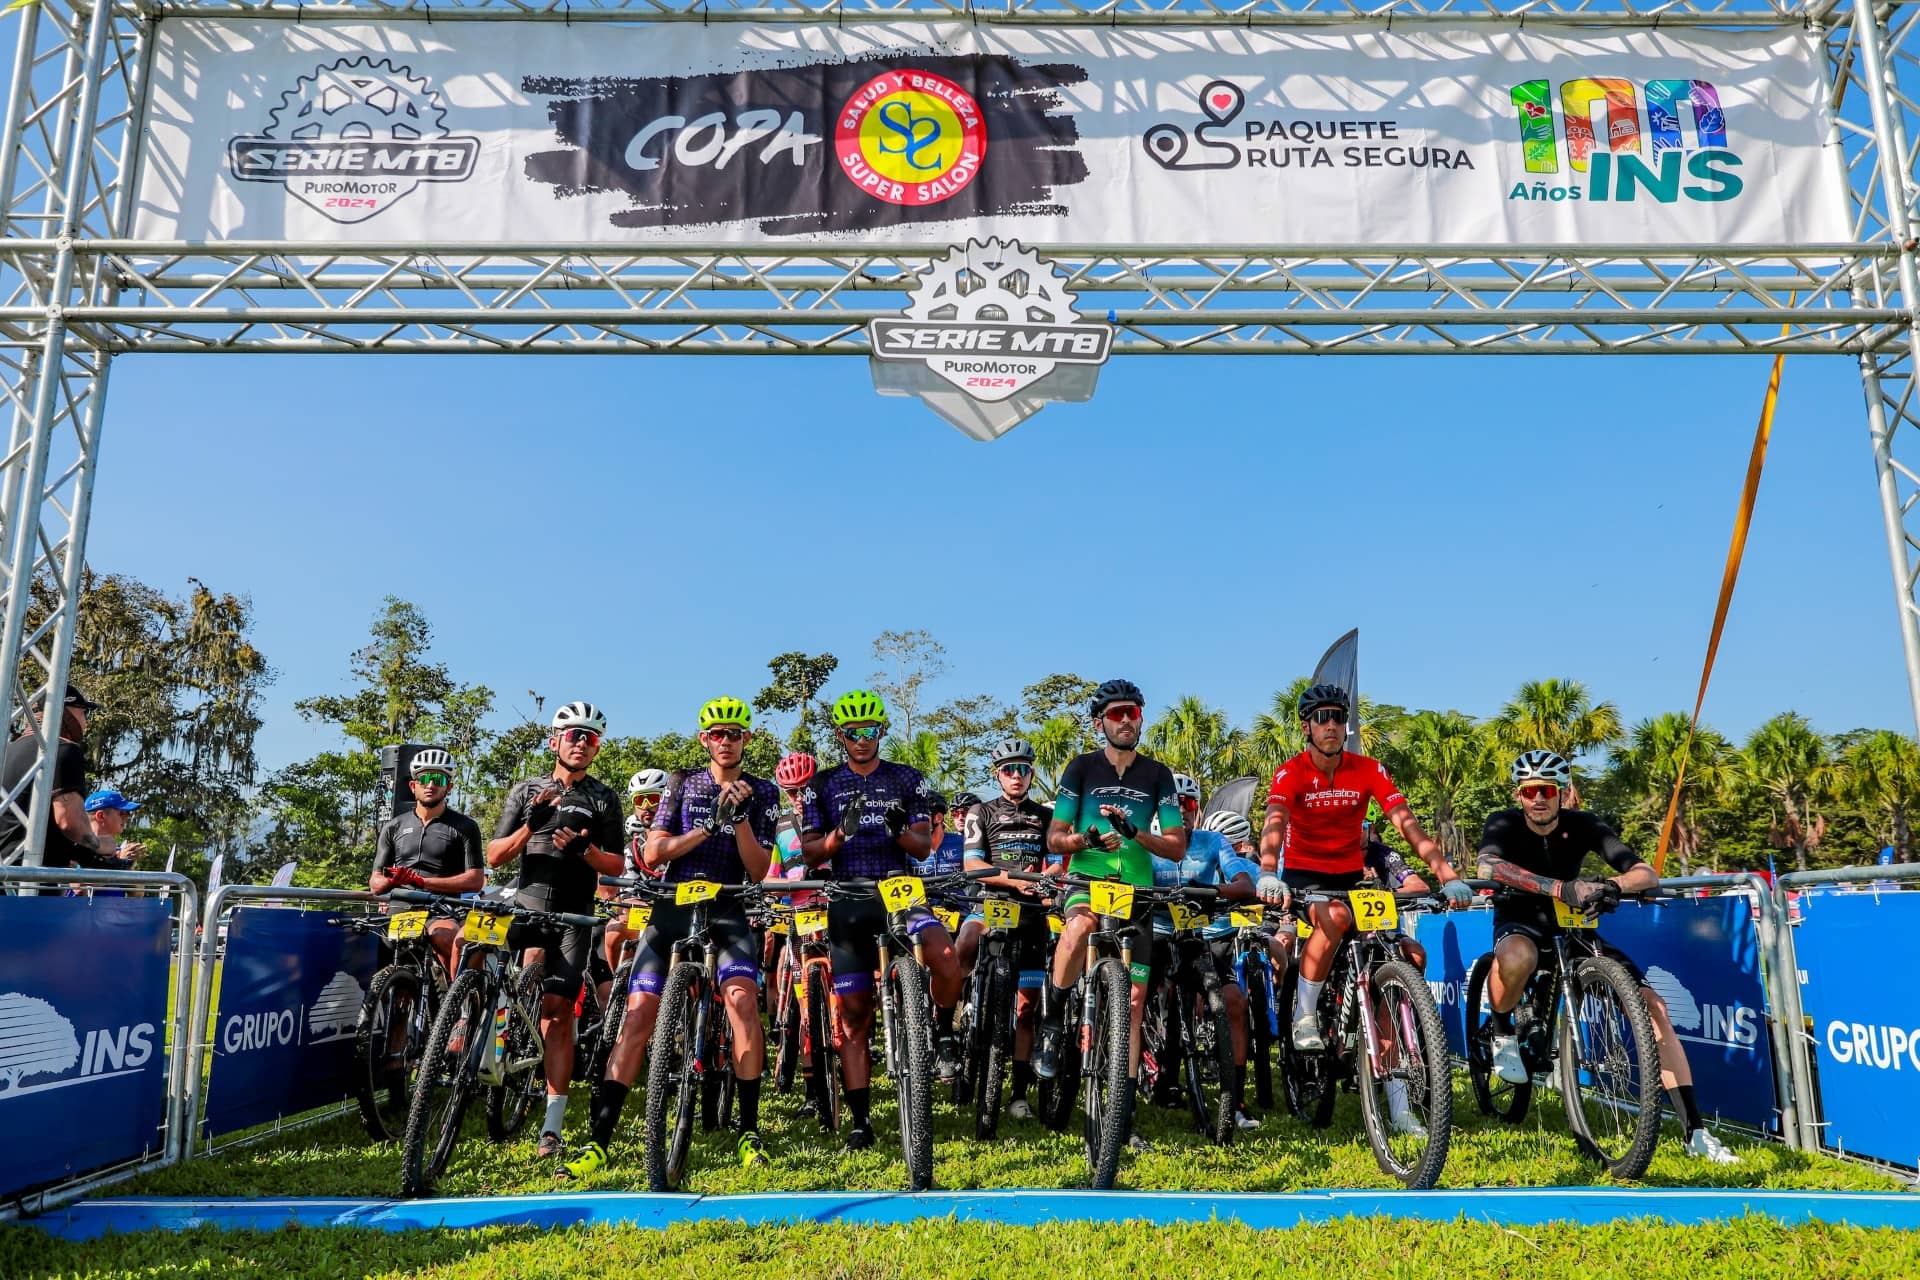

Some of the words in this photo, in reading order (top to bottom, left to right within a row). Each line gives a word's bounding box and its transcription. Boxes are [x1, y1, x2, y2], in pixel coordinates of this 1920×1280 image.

[842, 79, 888, 131] SALUD
[891, 74, 905, 89] Y
[910, 75, 979, 131] BELLEZA
[623, 108, 824, 171] COPA
[1245, 119, 1399, 142] PAQUETE
[243, 147, 365, 171] SERIE
[371, 147, 460, 171] MTB
[1246, 147, 1333, 169] RUTA
[1343, 147, 1476, 171] SEGURA
[842, 150, 906, 201] SUPER
[917, 151, 980, 202] SALON
[1508, 180, 1582, 202] Años
[1587, 149, 1744, 204] INS
[324, 198, 377, 209] 2024
[884, 328, 1008, 351] SERIE
[1010, 330, 1101, 354] MTB
[966, 377, 1017, 388] 2024
[997, 832, 1042, 840] SCOTT
[688, 885, 707, 894] 18
[890, 884, 913, 899] 49
[992, 907, 1011, 918] 52
[1362, 900, 1386, 917] 29
[477, 915, 497, 931] 14
[223, 1008, 294, 1053] GRUPO
[1703, 1003, 1758, 1044] INS
[80, 1023, 155, 1077] INS
